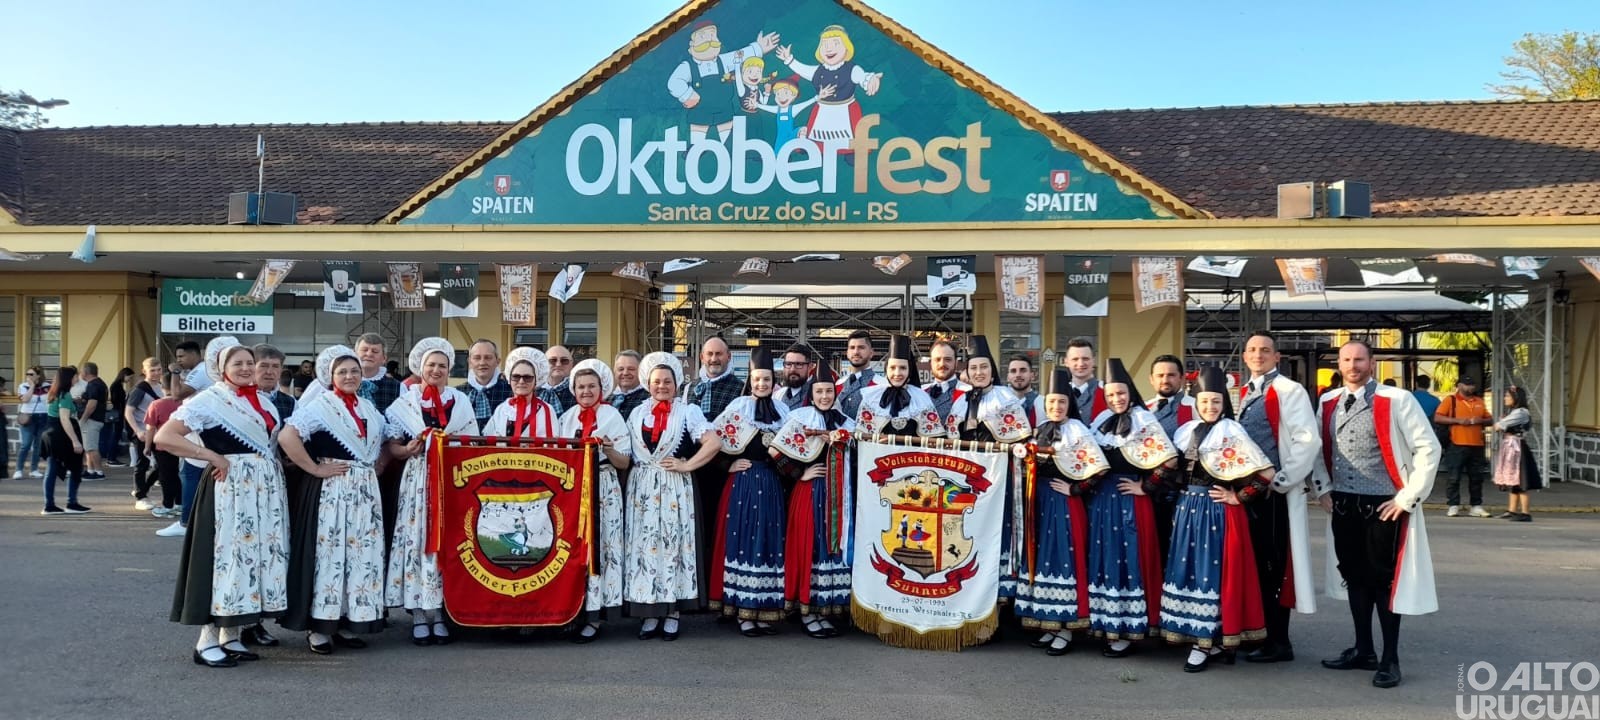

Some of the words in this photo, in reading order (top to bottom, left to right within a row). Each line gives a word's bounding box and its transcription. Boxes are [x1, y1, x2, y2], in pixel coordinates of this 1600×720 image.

[565, 113, 991, 196] Oktoberfest
[471, 196, 534, 214] SPATEN
[1025, 193, 1097, 212] SPATEN
[648, 202, 711, 222] Santa
[717, 202, 769, 221] Cruz
[778, 202, 806, 221] do
[811, 202, 847, 221] Sul
[867, 202, 898, 221] RS
[443, 278, 475, 288] SPATEN
[1068, 273, 1108, 284] SPATEN
[178, 317, 256, 331] Bilheteria
[464, 457, 566, 473] Volkstanzgruppe
